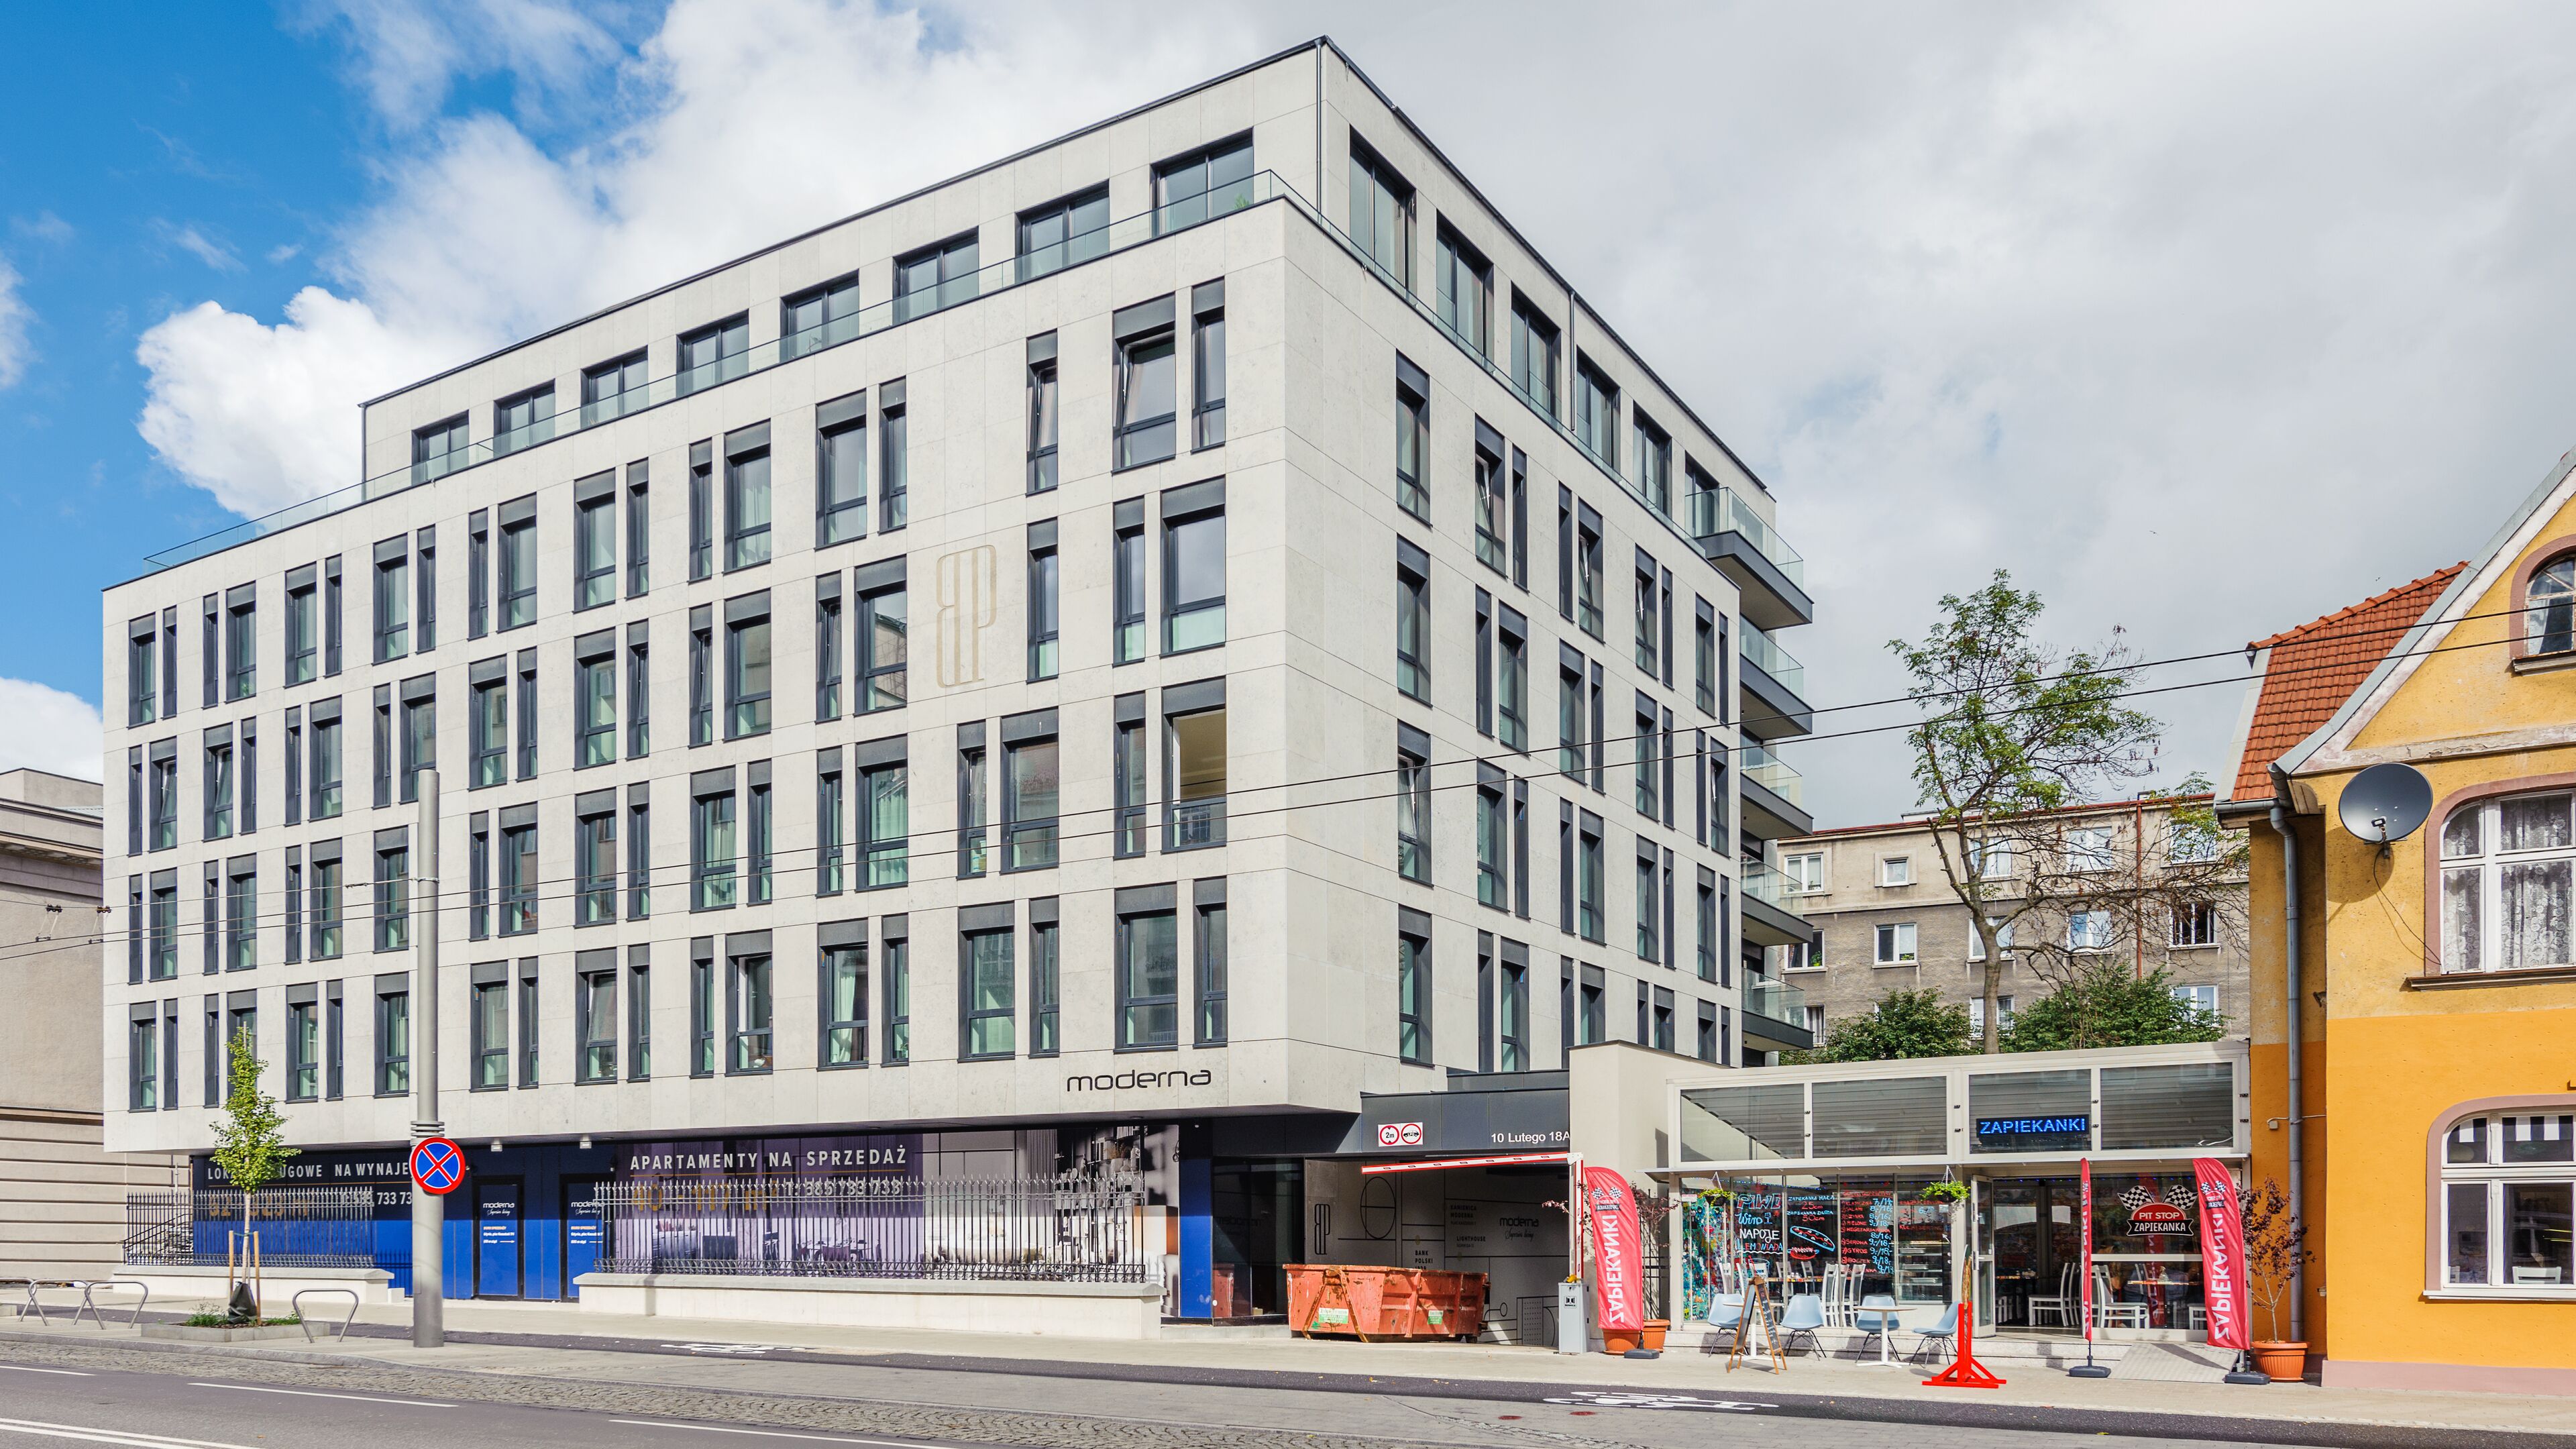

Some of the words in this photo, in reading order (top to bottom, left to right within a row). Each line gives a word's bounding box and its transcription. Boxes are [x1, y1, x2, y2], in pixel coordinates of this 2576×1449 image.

[1067, 1069, 1212, 1092] moderna
[1980, 1118, 2086, 1134] ZAPIEKANKI
[1491, 1133, 1504, 1143] 10
[1508, 1132, 1546, 1144] Lutego
[1549, 1131, 1570, 1141] 18A
[631, 1152, 758, 1171] APARTAMENTY
[769, 1152, 792, 1167] NA
[807, 1144, 906, 1166] SPRZEDAŻ
[335, 1163, 351, 1177] NA
[356, 1162, 411, 1177] WYNAJE
[376, 1191, 396, 1205] 733
[399, 1191, 412, 1205] 73
[1499, 1216, 1540, 1227] moderna
[2155, 1212, 2180, 1220] STOP
[2134, 1222, 2186, 1232] ZAPIEKANKA
[1739, 1228, 1780, 1244] NAPOJE
